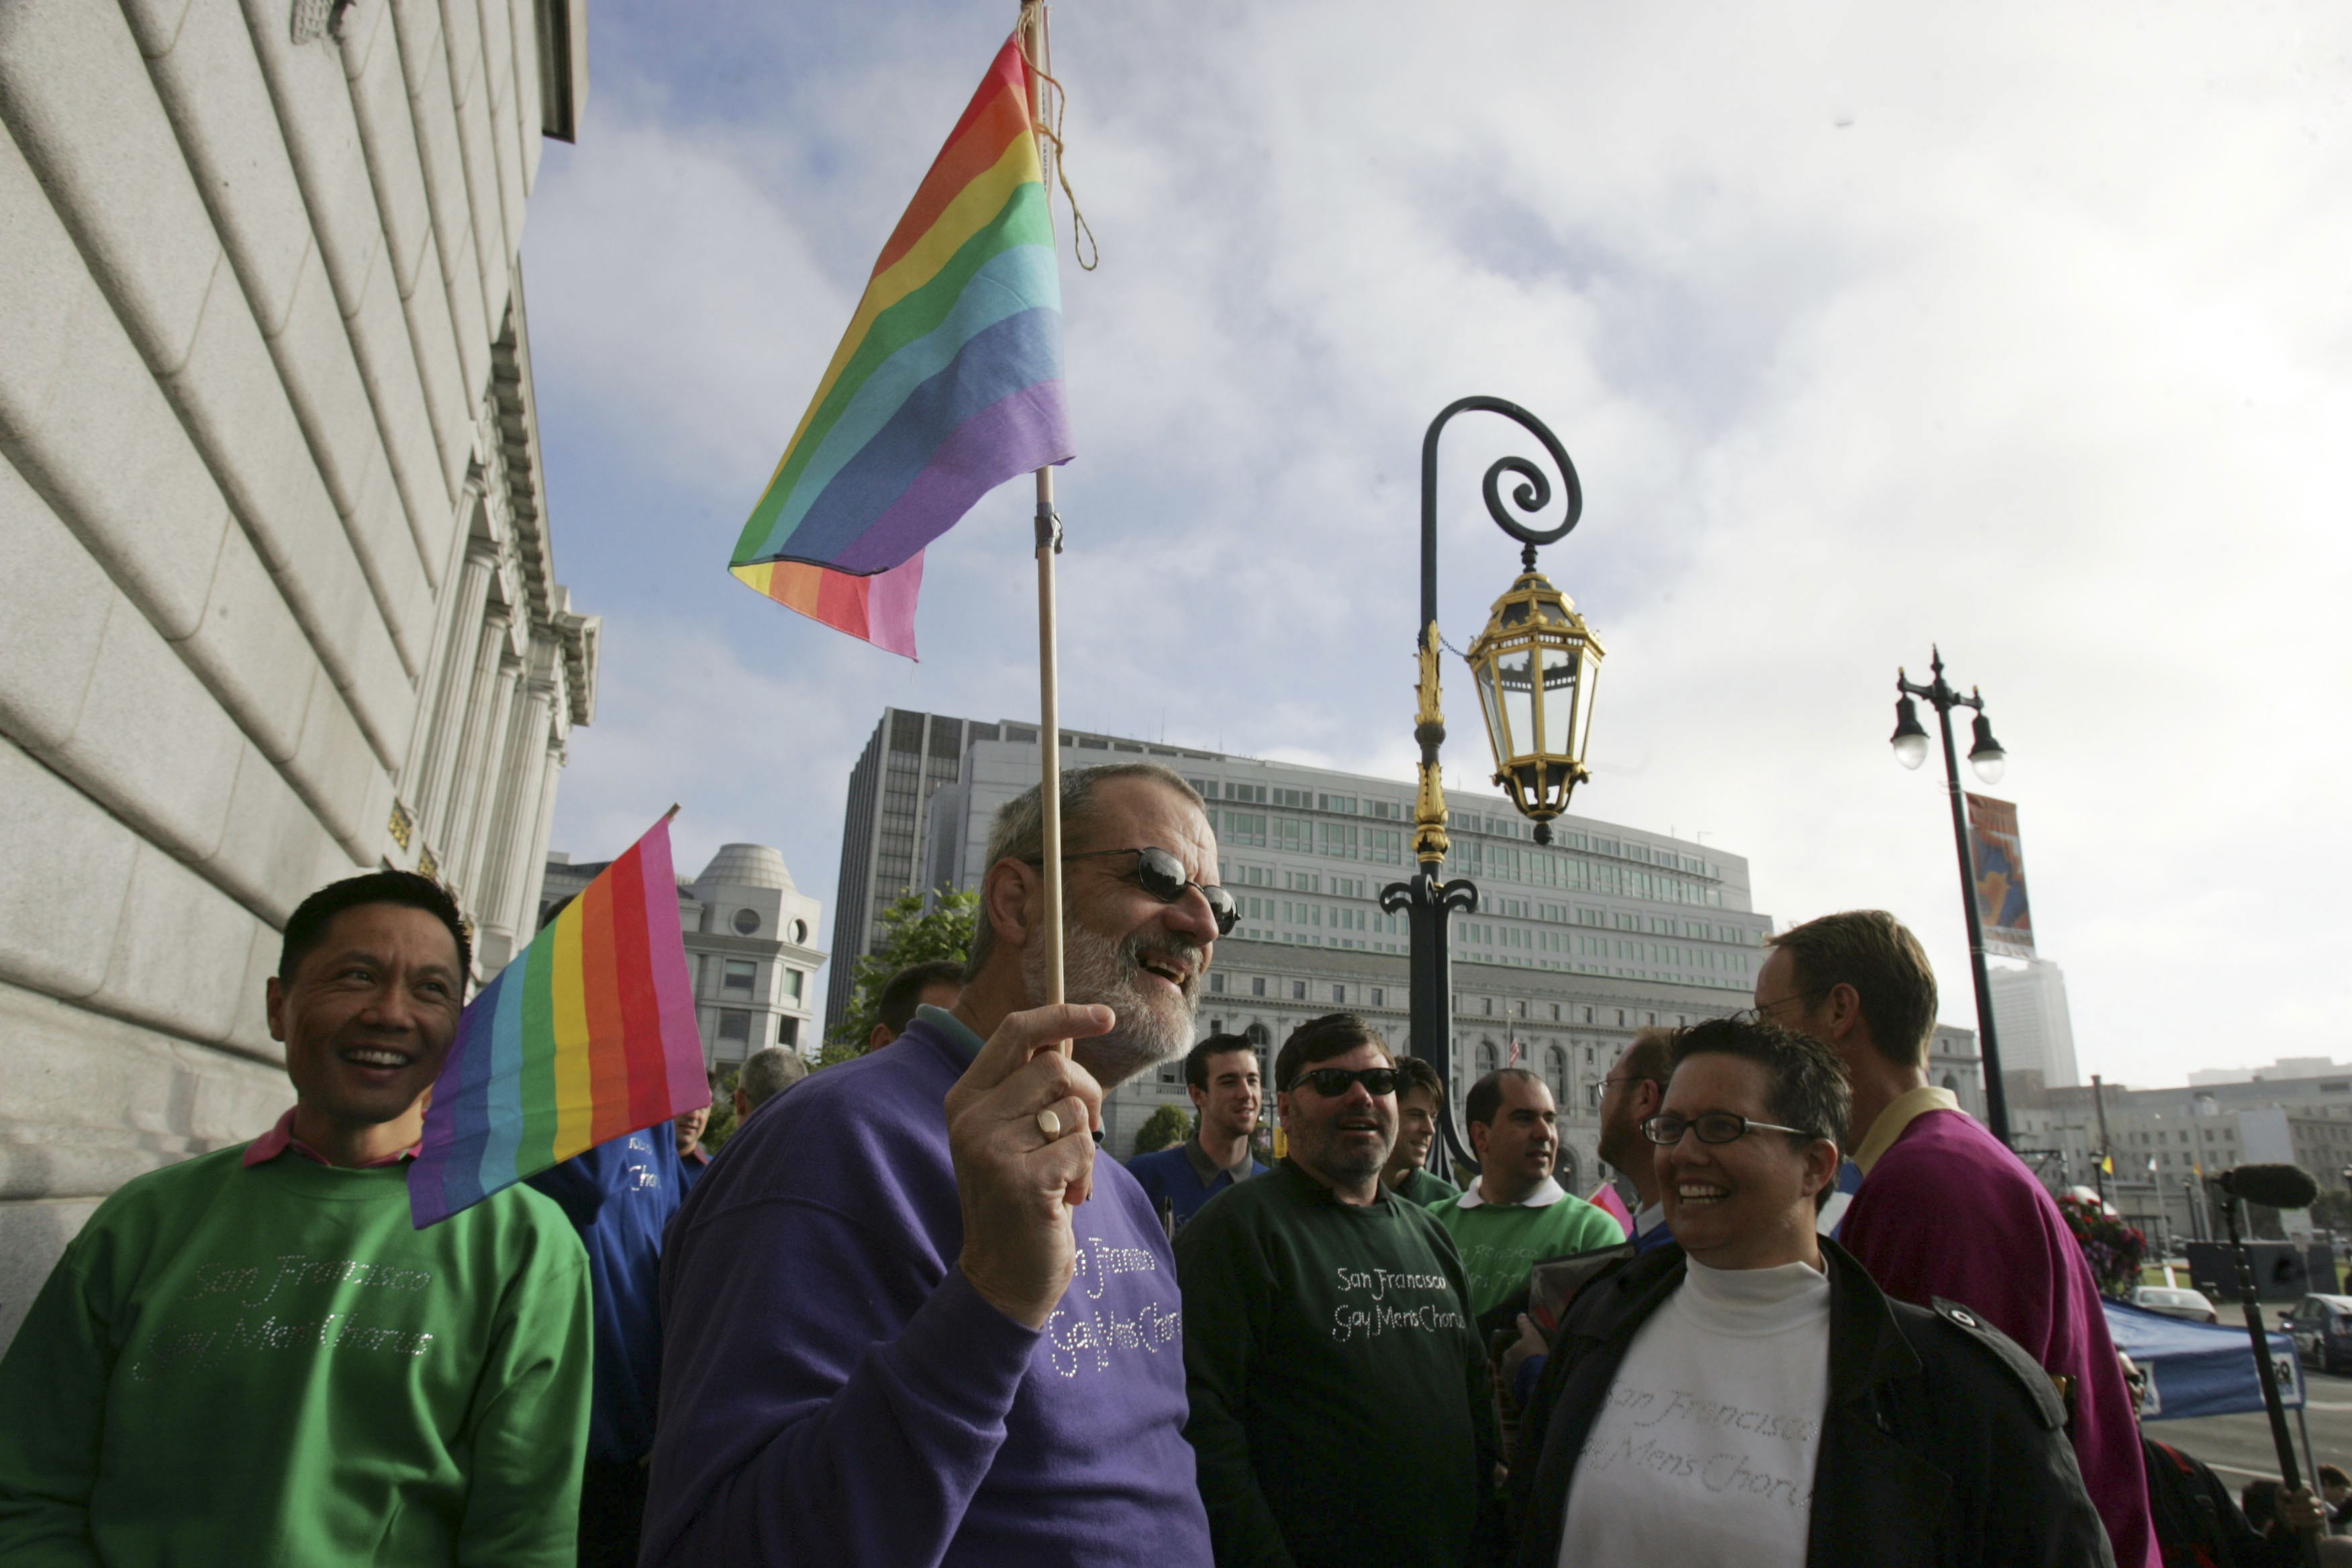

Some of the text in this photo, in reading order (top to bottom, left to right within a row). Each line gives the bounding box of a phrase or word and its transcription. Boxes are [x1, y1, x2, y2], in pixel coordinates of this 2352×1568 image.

[181, 1254, 433, 1308] San Francisco
[1337, 1267, 1373, 1292] San
[1371, 1267, 1447, 1302] Francisco
[319, 1312, 435, 1357] Chorus
[1331, 1304, 1372, 1344] Gay
[1371, 1303, 1420, 1337] Men's
[1607, 1379, 1820, 1442] an Francisco
[1700, 1451, 1813, 1508] Choru
